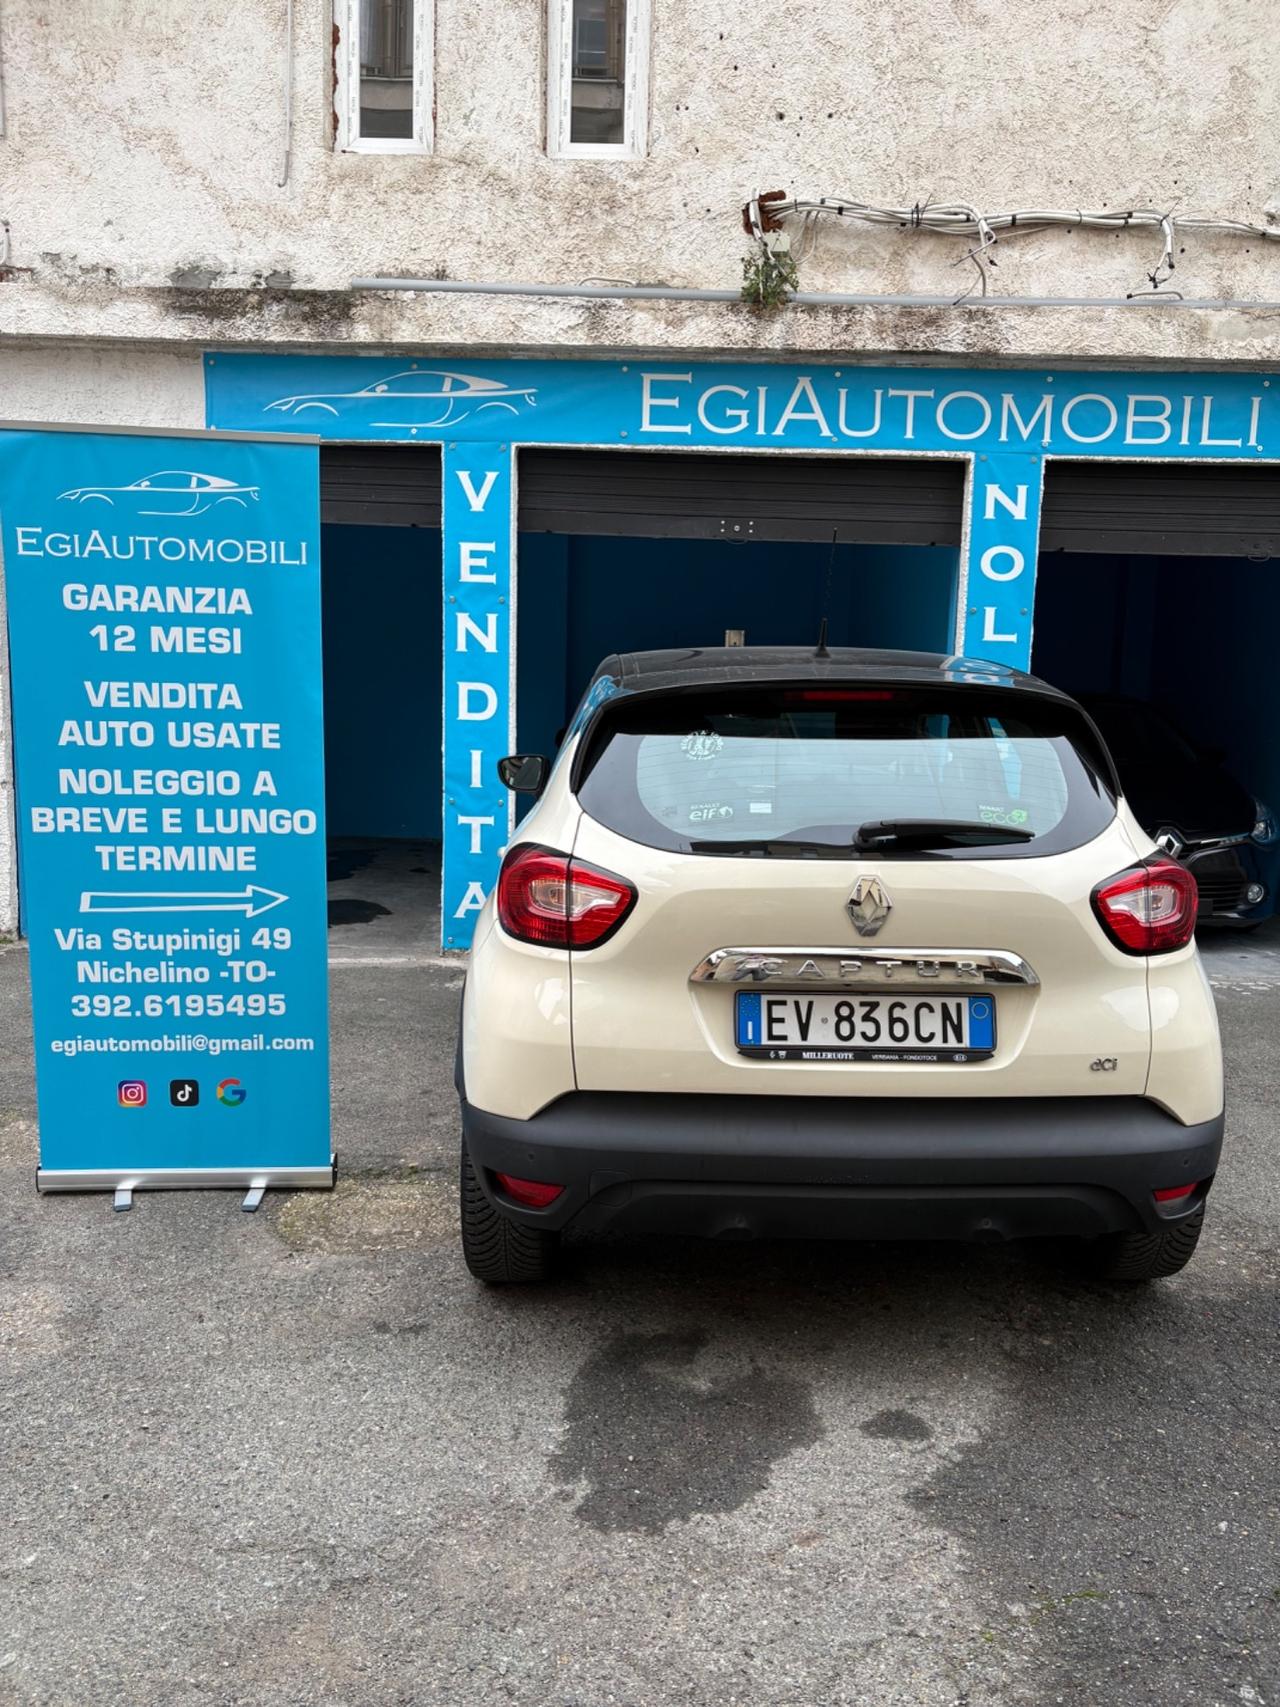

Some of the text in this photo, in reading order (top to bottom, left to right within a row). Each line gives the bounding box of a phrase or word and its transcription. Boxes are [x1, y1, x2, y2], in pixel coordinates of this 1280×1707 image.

[981, 484, 1029, 644] NOL
[63, 584, 252, 614] GARANZIA
[90, 625, 242, 654] 12 MESI
[84, 681, 243, 710] VENDITA
[454, 471, 498, 919] VENDITA
[58, 720, 281, 749] AUTO USATE
[59, 768, 278, 796] NOLEGGIO A
[31, 807, 317, 835] BREVE E LUNGO
[95, 845, 257, 871] TERMINE
[55, 927, 291, 956] Via Stupinigi 49
[77, 961, 276, 983] Nichelino -TO-
[758, 958, 983, 978] CAPTUR
[71, 994, 286, 1017] 392.6195495
[51, 1034, 314, 1057] egiautomobili@gmail.com
[802, 1051, 855, 1060] MILLERUOTE
